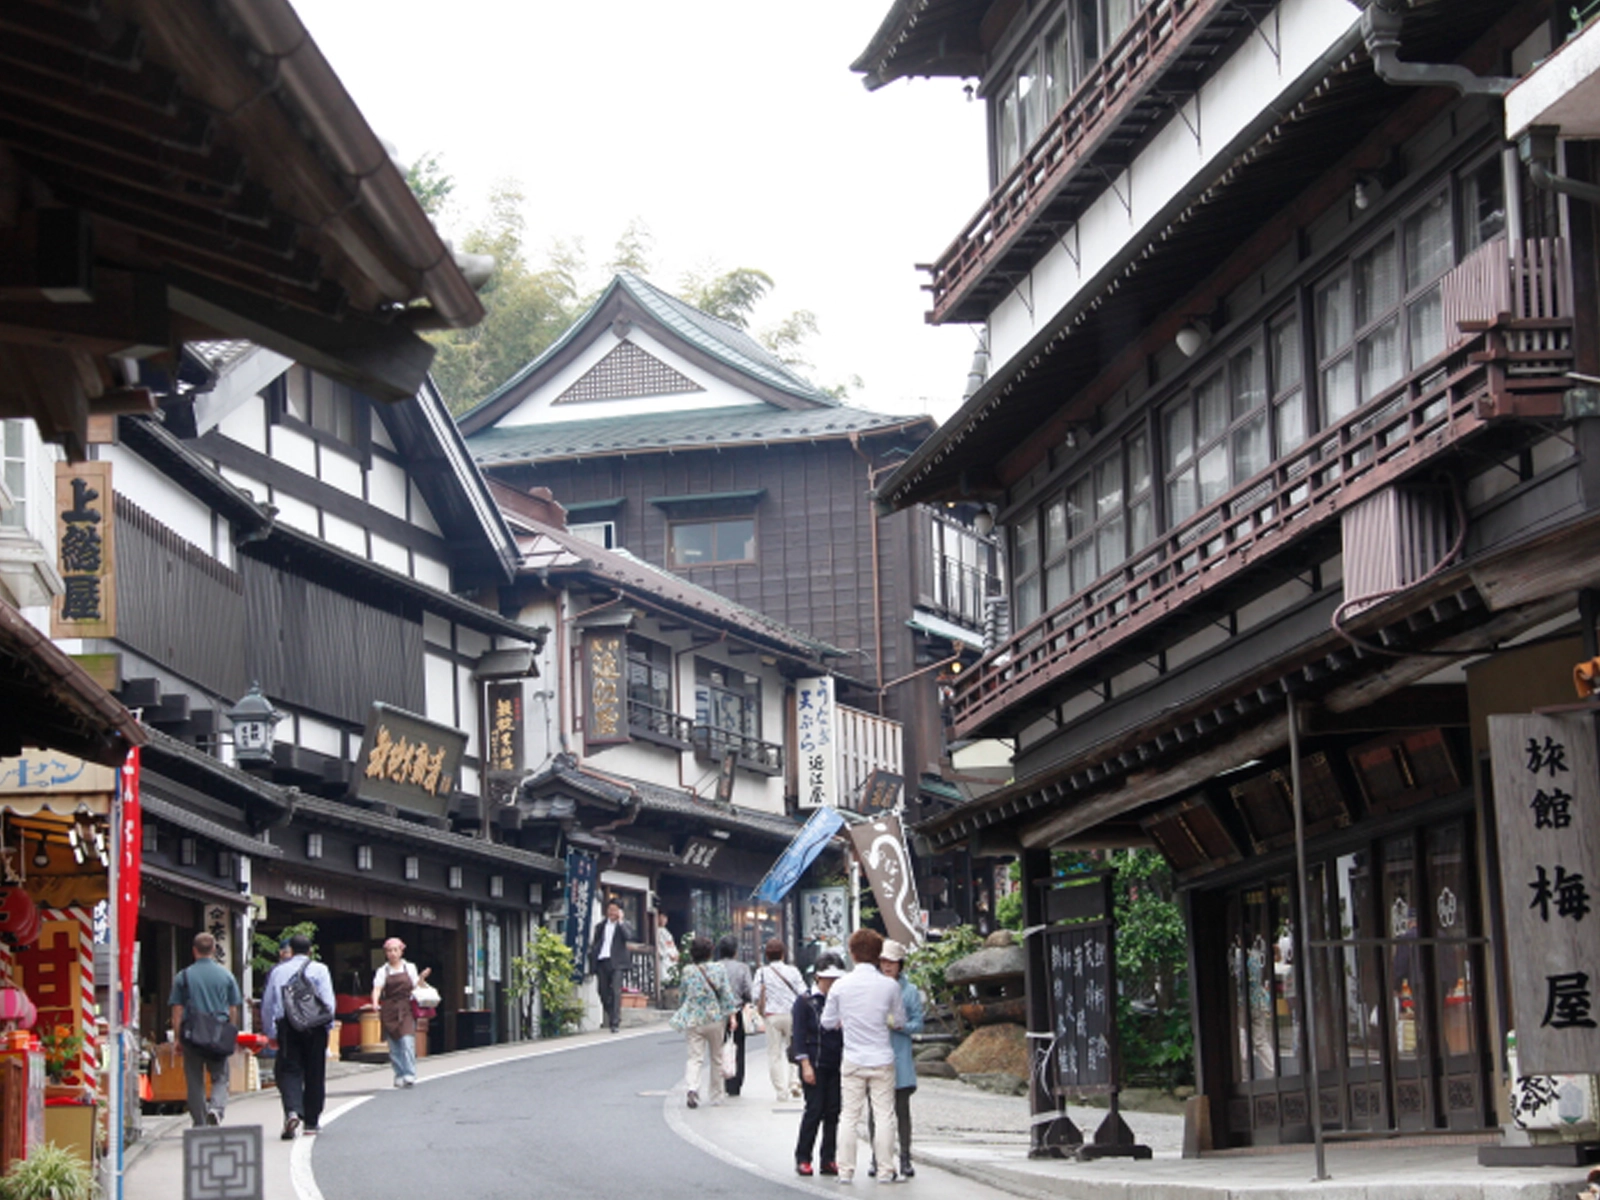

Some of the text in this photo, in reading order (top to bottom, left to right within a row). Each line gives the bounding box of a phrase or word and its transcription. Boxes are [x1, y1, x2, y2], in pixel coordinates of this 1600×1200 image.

[798, 689, 816, 752] 天ぷら
[808, 754, 826, 803] 近江屋
[1525, 735, 1598, 1030] 旅館梅屋
